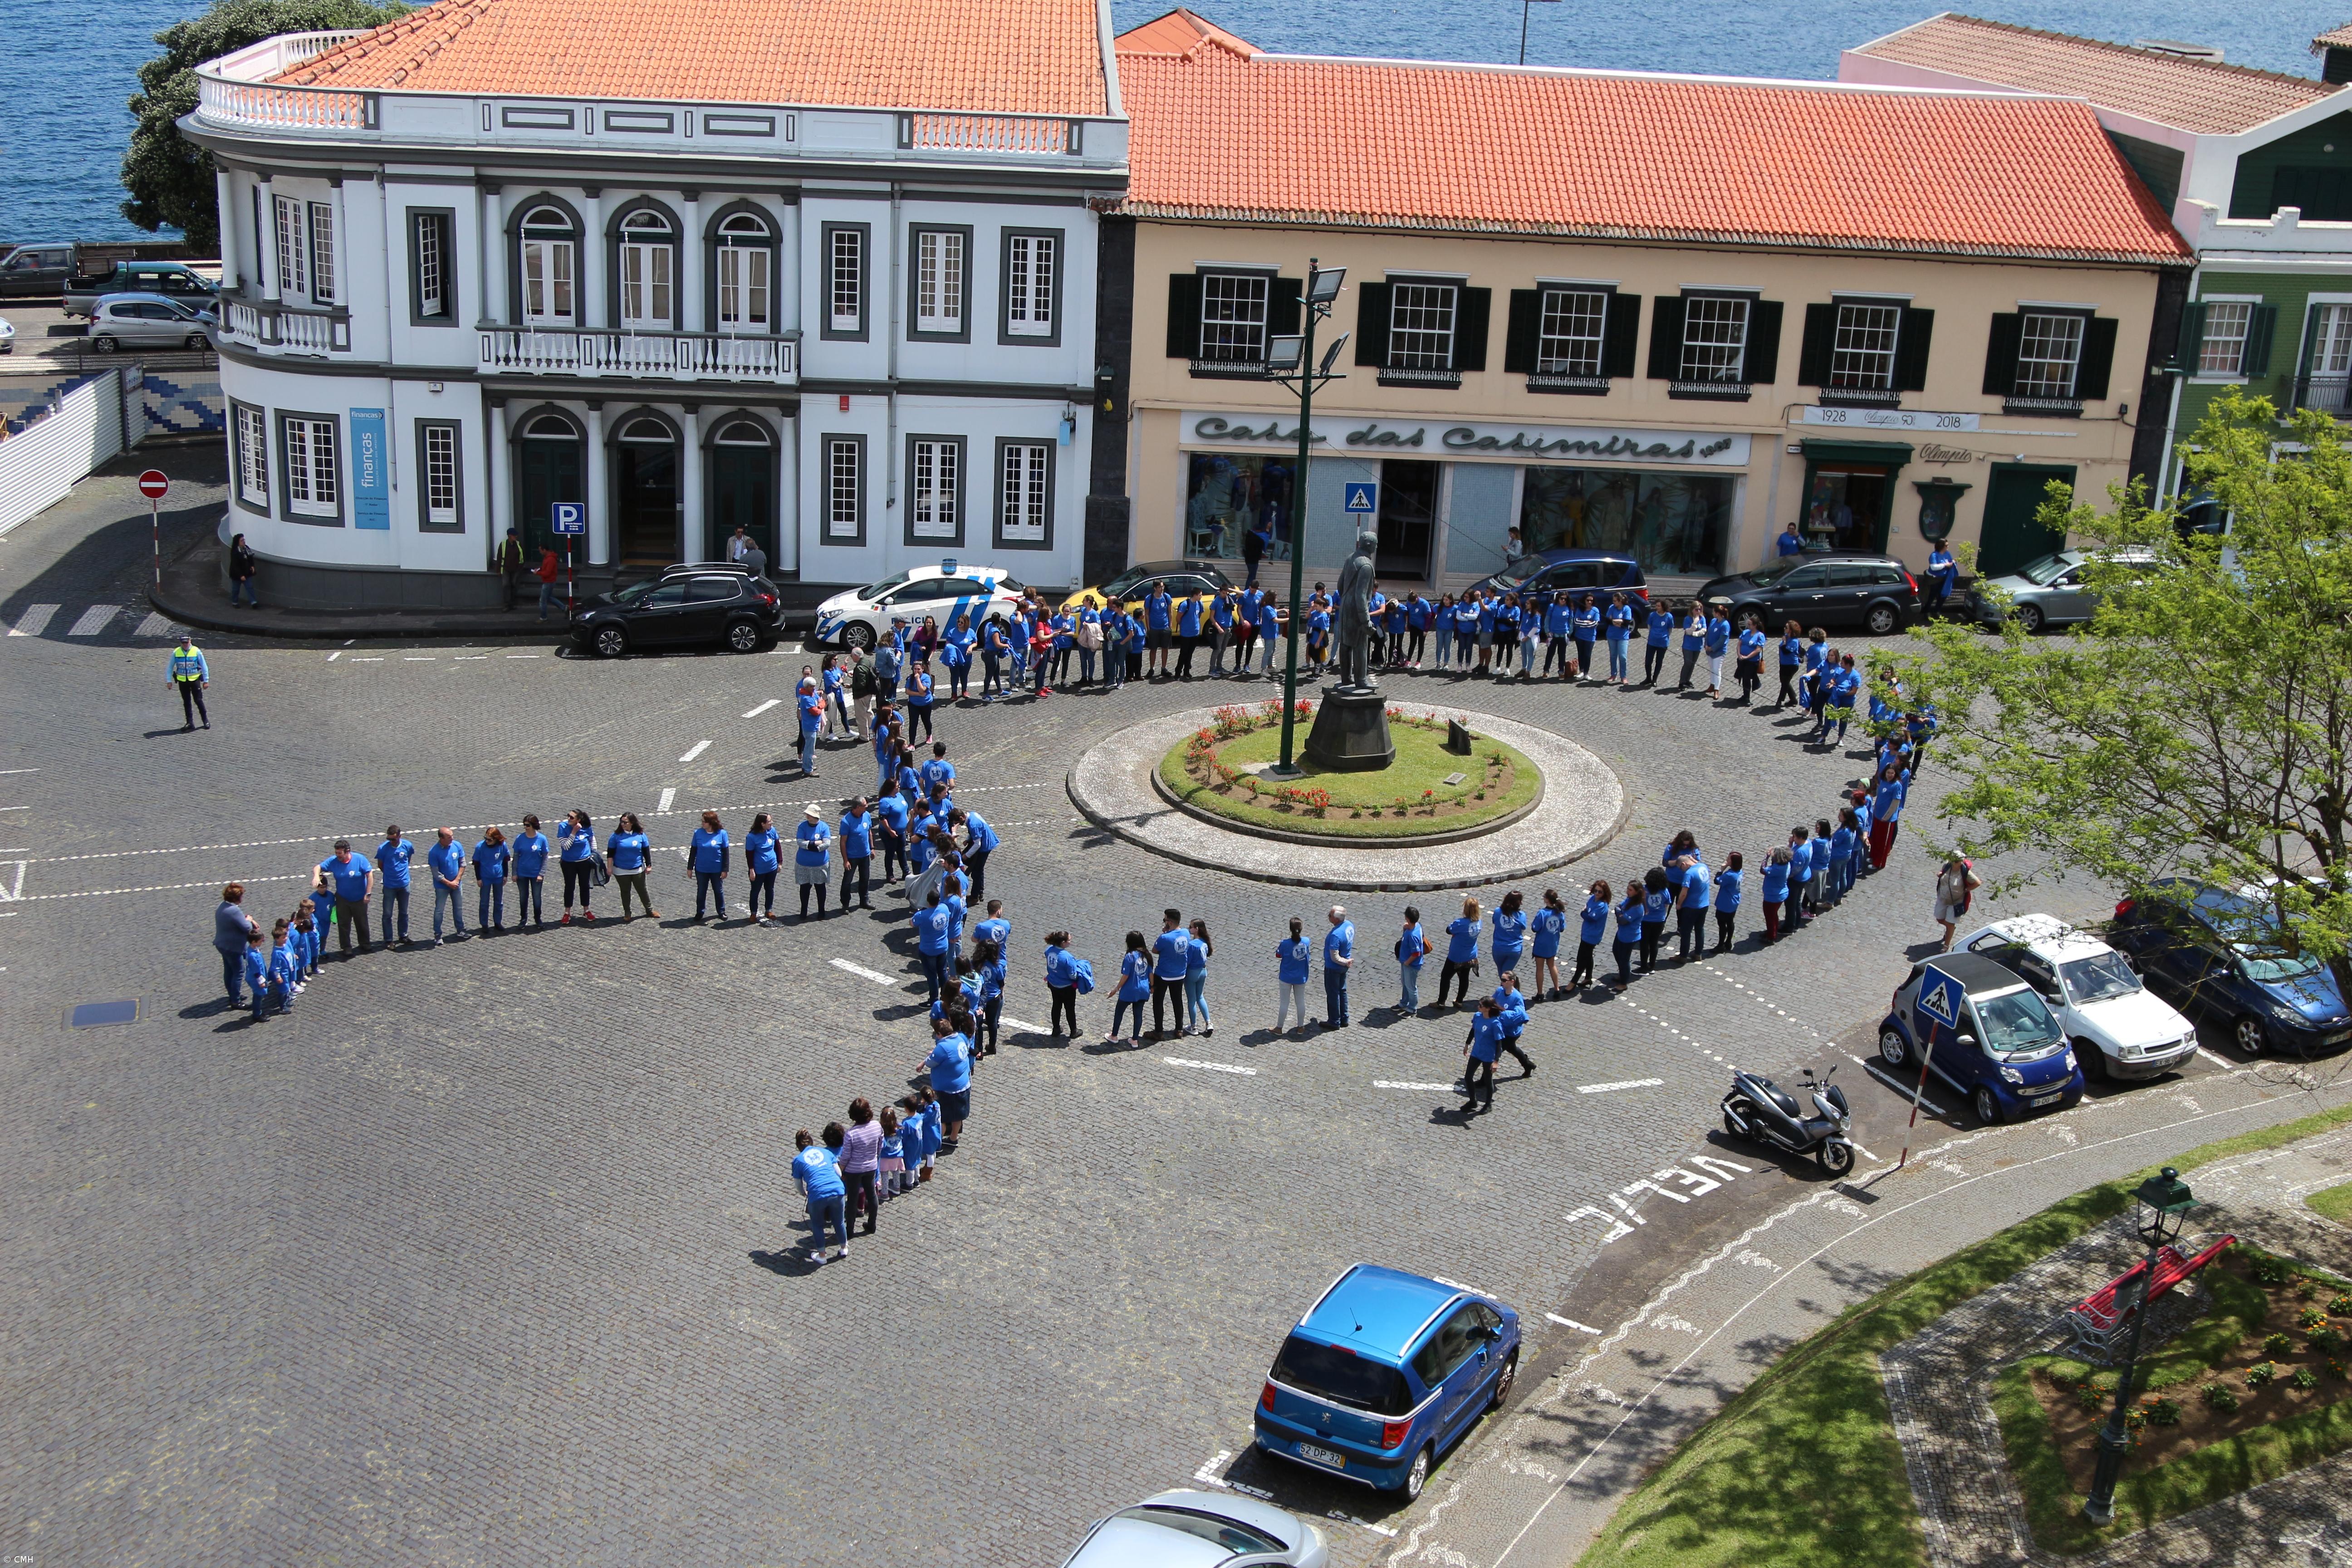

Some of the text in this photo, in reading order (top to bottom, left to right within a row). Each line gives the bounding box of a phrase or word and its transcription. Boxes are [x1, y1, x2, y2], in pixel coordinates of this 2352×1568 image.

[1822, 409, 1846, 422] 1928
[1901, 415, 1913, 425] 90
[1936, 416, 1961, 428] 2018
[1346, 424, 1425, 447] das
[1442, 427, 1695, 458] Casimiras
[361, 432, 374, 488] finanças
[559, 505, 578, 531] P
